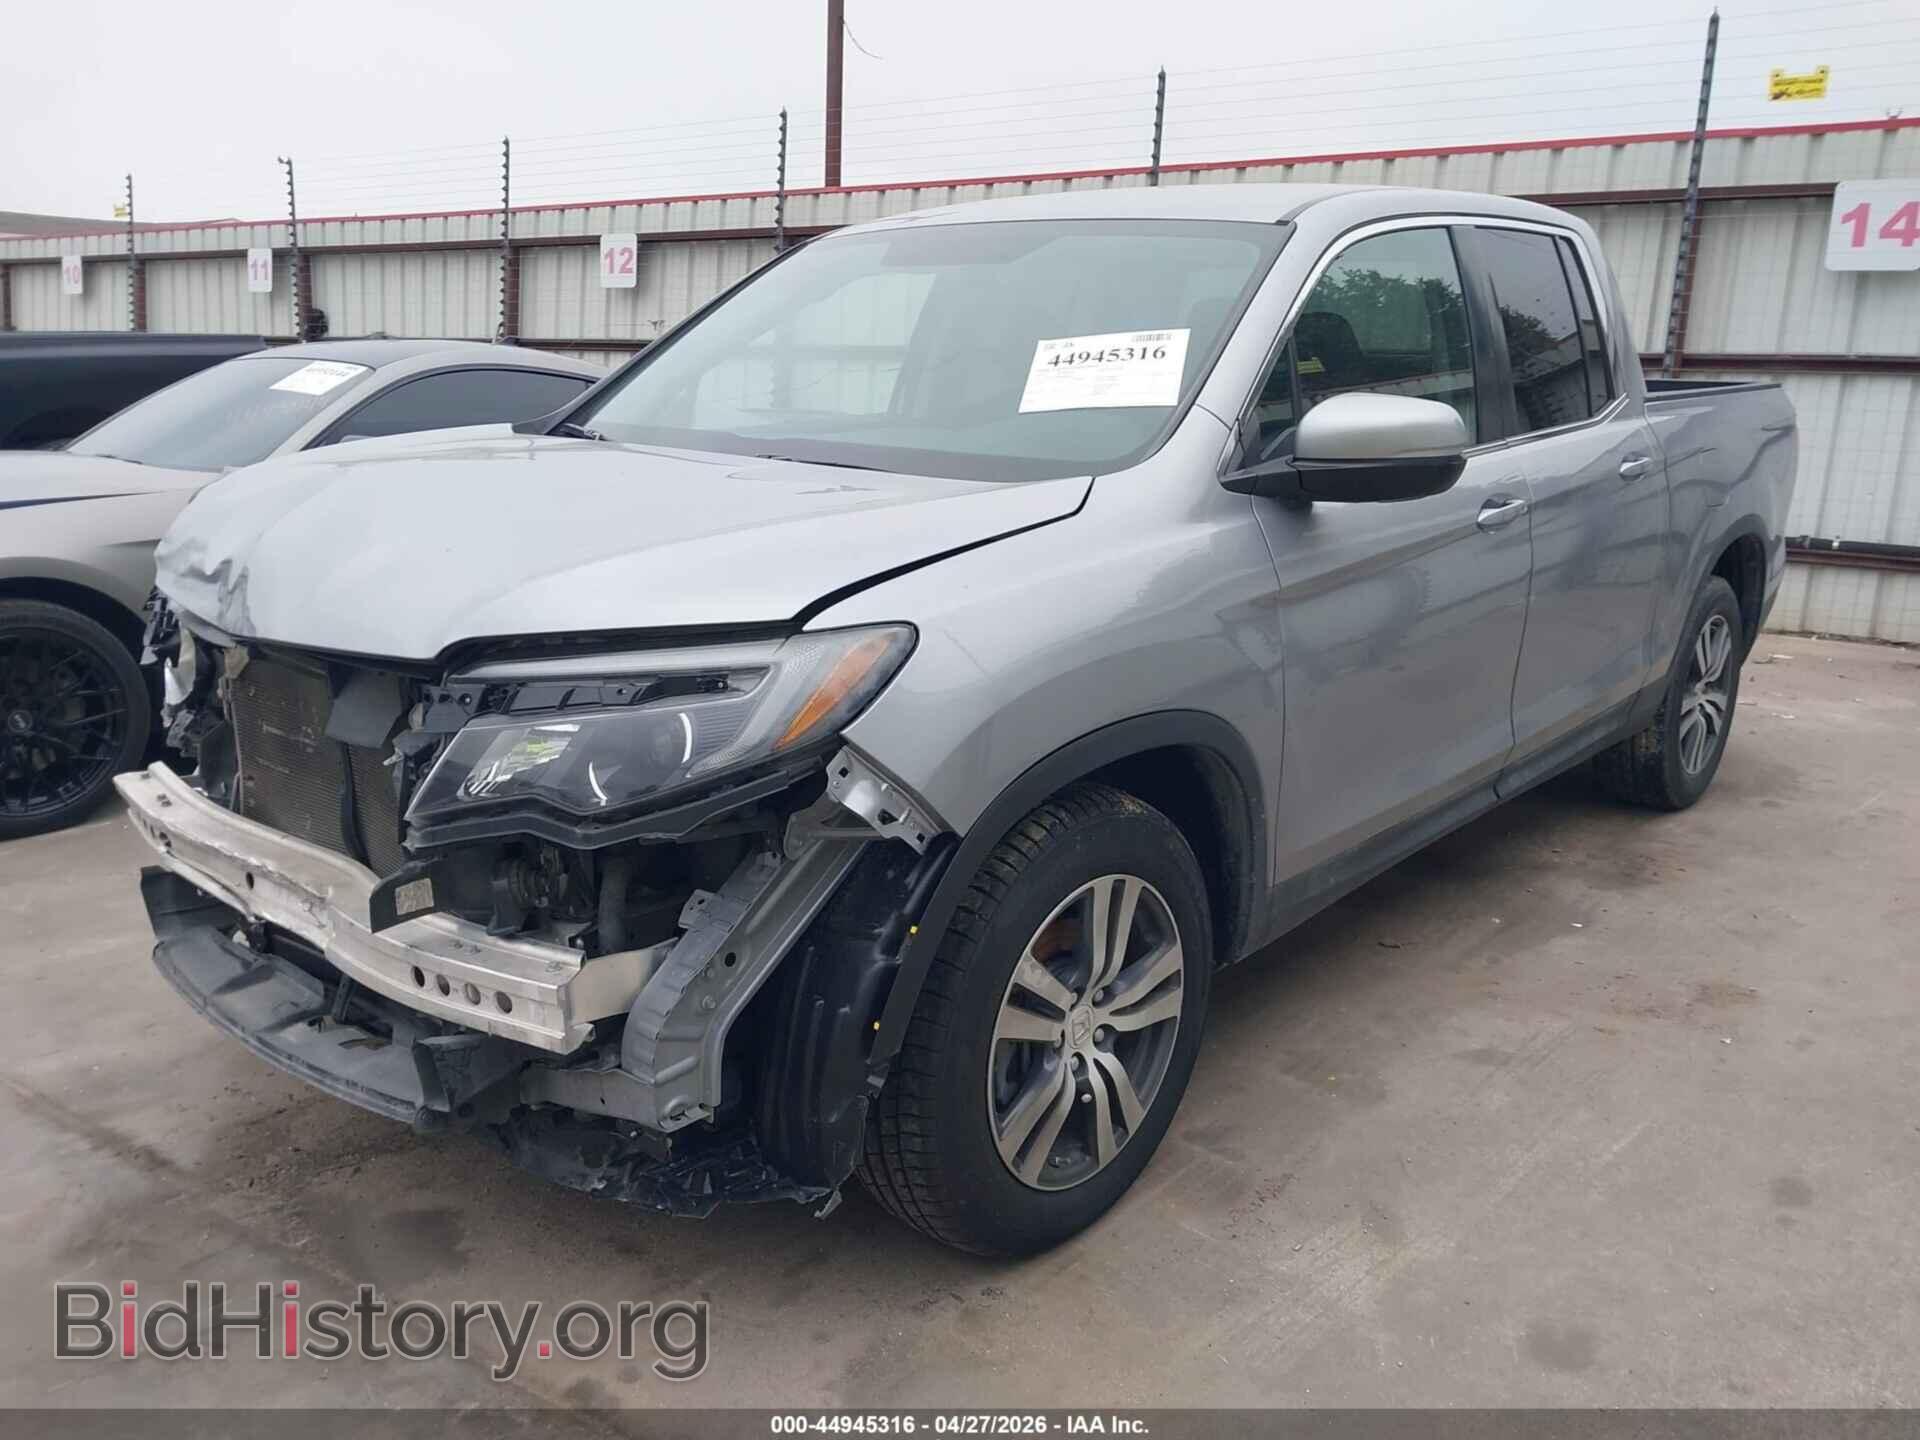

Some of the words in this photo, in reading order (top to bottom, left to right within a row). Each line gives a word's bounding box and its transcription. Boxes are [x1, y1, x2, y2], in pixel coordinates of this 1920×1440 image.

[1840, 201, 1920, 248] 14
[250, 258, 268, 281] 11
[604, 247, 633, 274] 12
[64, 264, 80, 284] 10
[1047, 345, 1166, 367] 44945316
